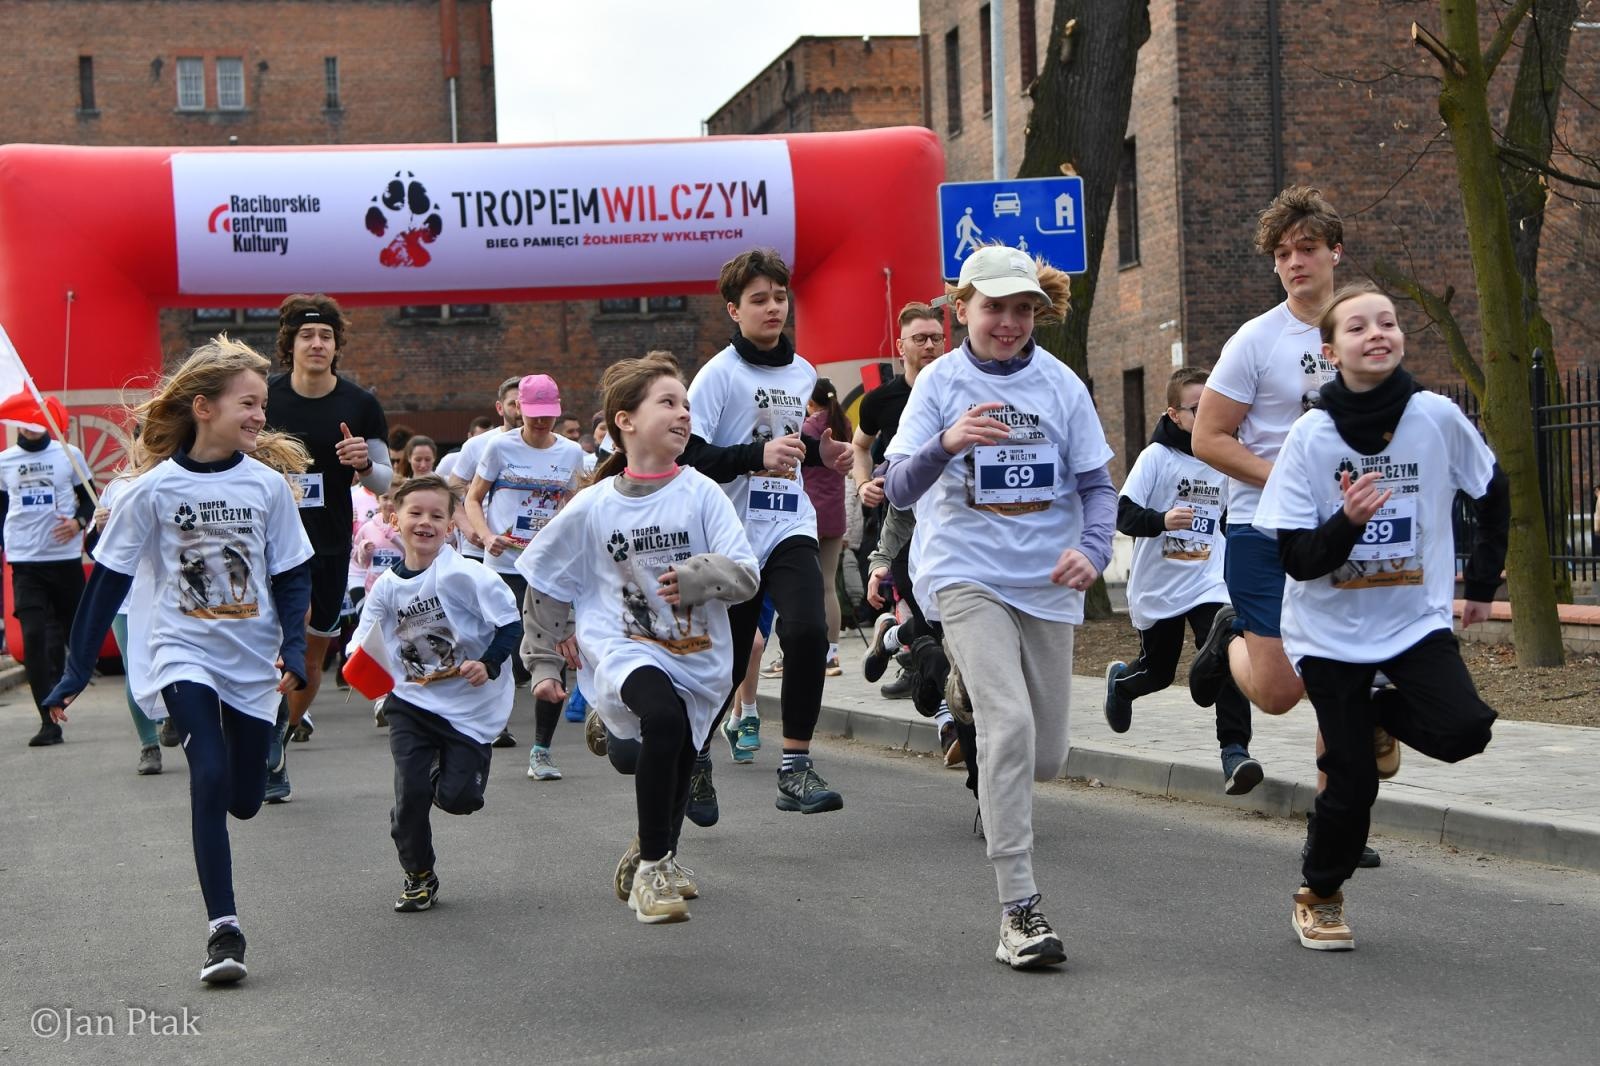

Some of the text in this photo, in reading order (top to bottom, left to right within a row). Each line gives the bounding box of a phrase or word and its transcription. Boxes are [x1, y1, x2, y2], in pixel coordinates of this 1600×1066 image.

[231, 195, 320, 213] Raciborskie
[233, 234, 288, 256] Kultury
[486, 228, 743, 248] BIEG PAMIĘCI ŻOŁNIERZY WYKLĘTYCH
[771, 395, 802, 406] WILCZYM
[1010, 453, 1037, 461] WILCZYM
[1360, 455, 1391, 466] TROPEM
[1004, 466, 1035, 488] 69
[31, 495, 45, 505] 74
[199, 500, 227, 511] TROPEM
[767, 493, 784, 510] 11
[200, 508, 253, 523] WILCZYM
[632, 526, 660, 538] TROPEM
[1191, 517, 1209, 532] 08
[1362, 521, 1394, 544] 89
[633, 531, 690, 552] WILCZYM
[380, 556, 393, 566] 22
[435, 611, 446, 621] 202
